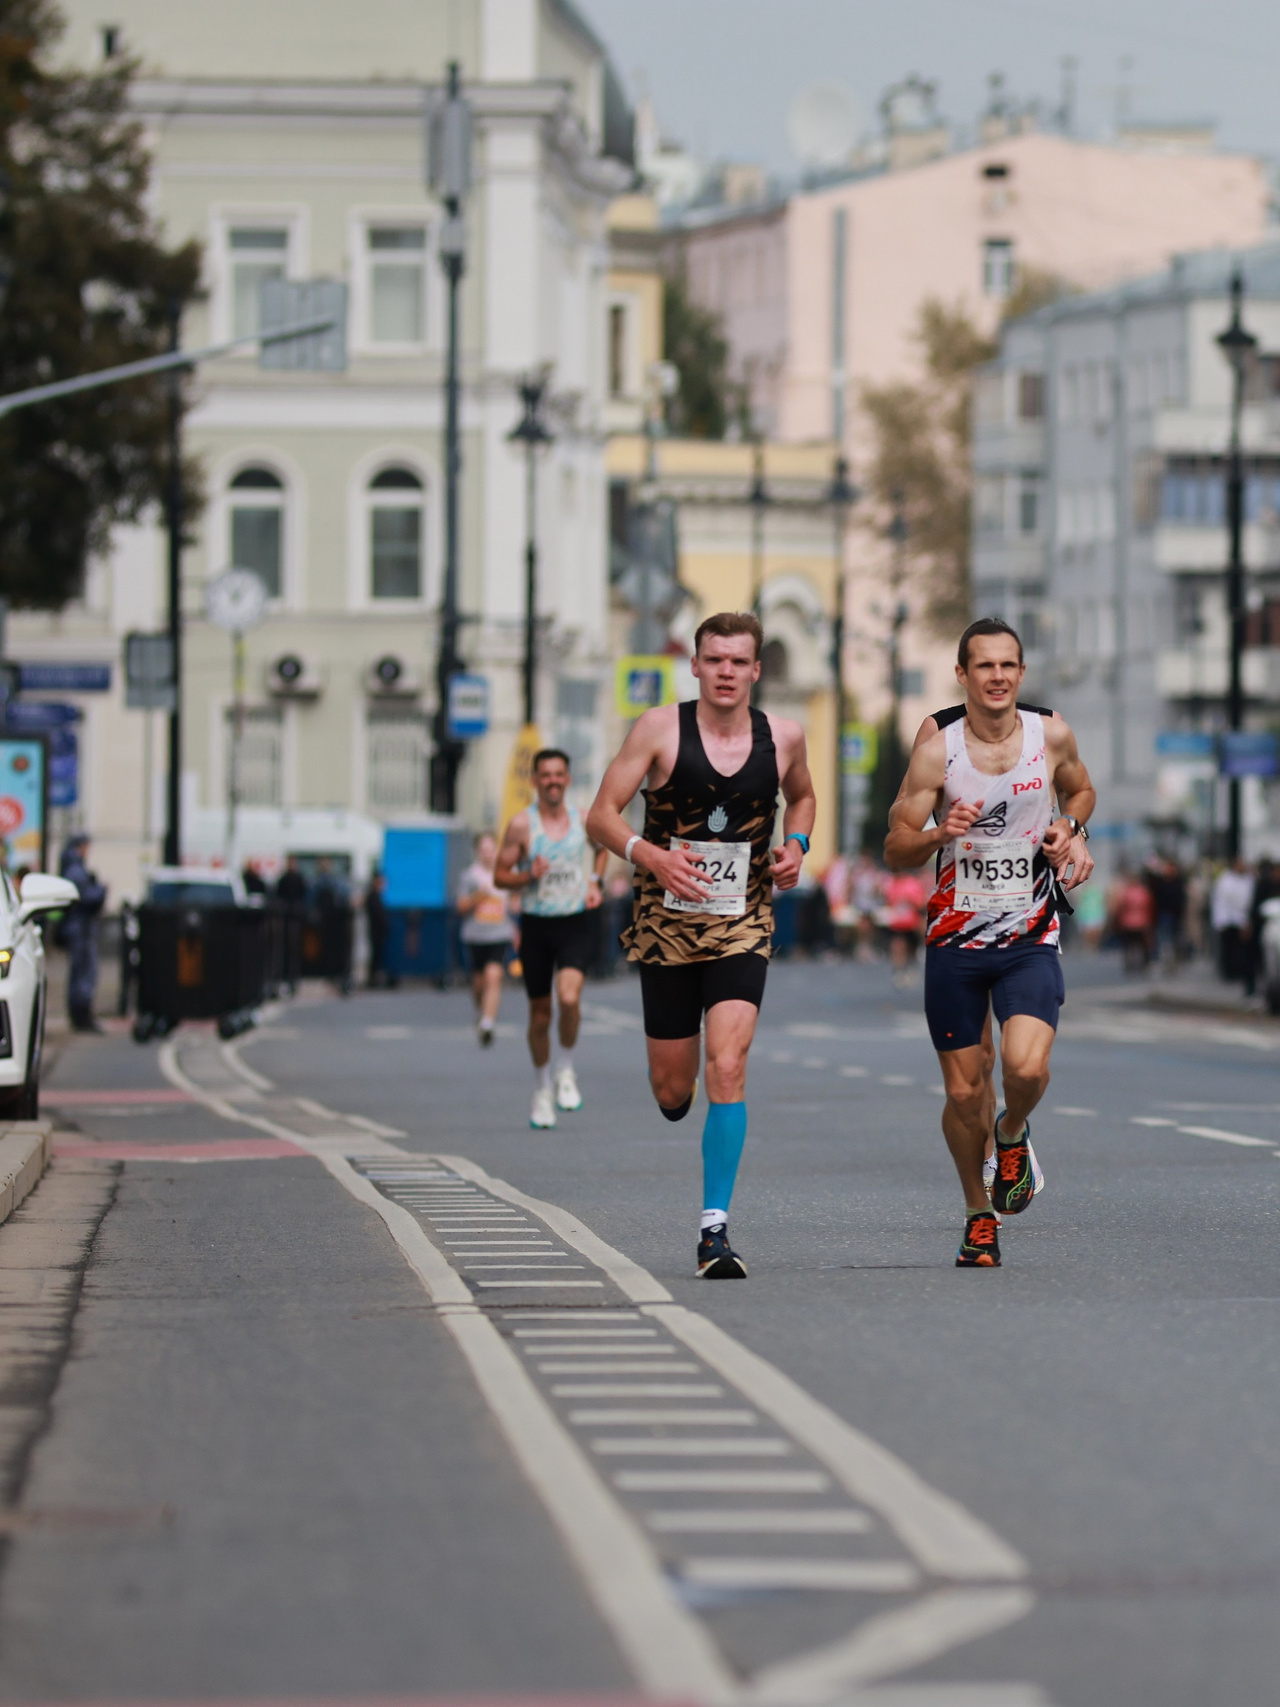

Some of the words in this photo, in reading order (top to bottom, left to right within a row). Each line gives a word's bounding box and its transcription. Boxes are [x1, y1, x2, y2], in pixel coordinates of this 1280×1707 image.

[690, 861, 737, 882] 924
[960, 858, 1028, 881] 19533
[961, 896, 971, 908] A
